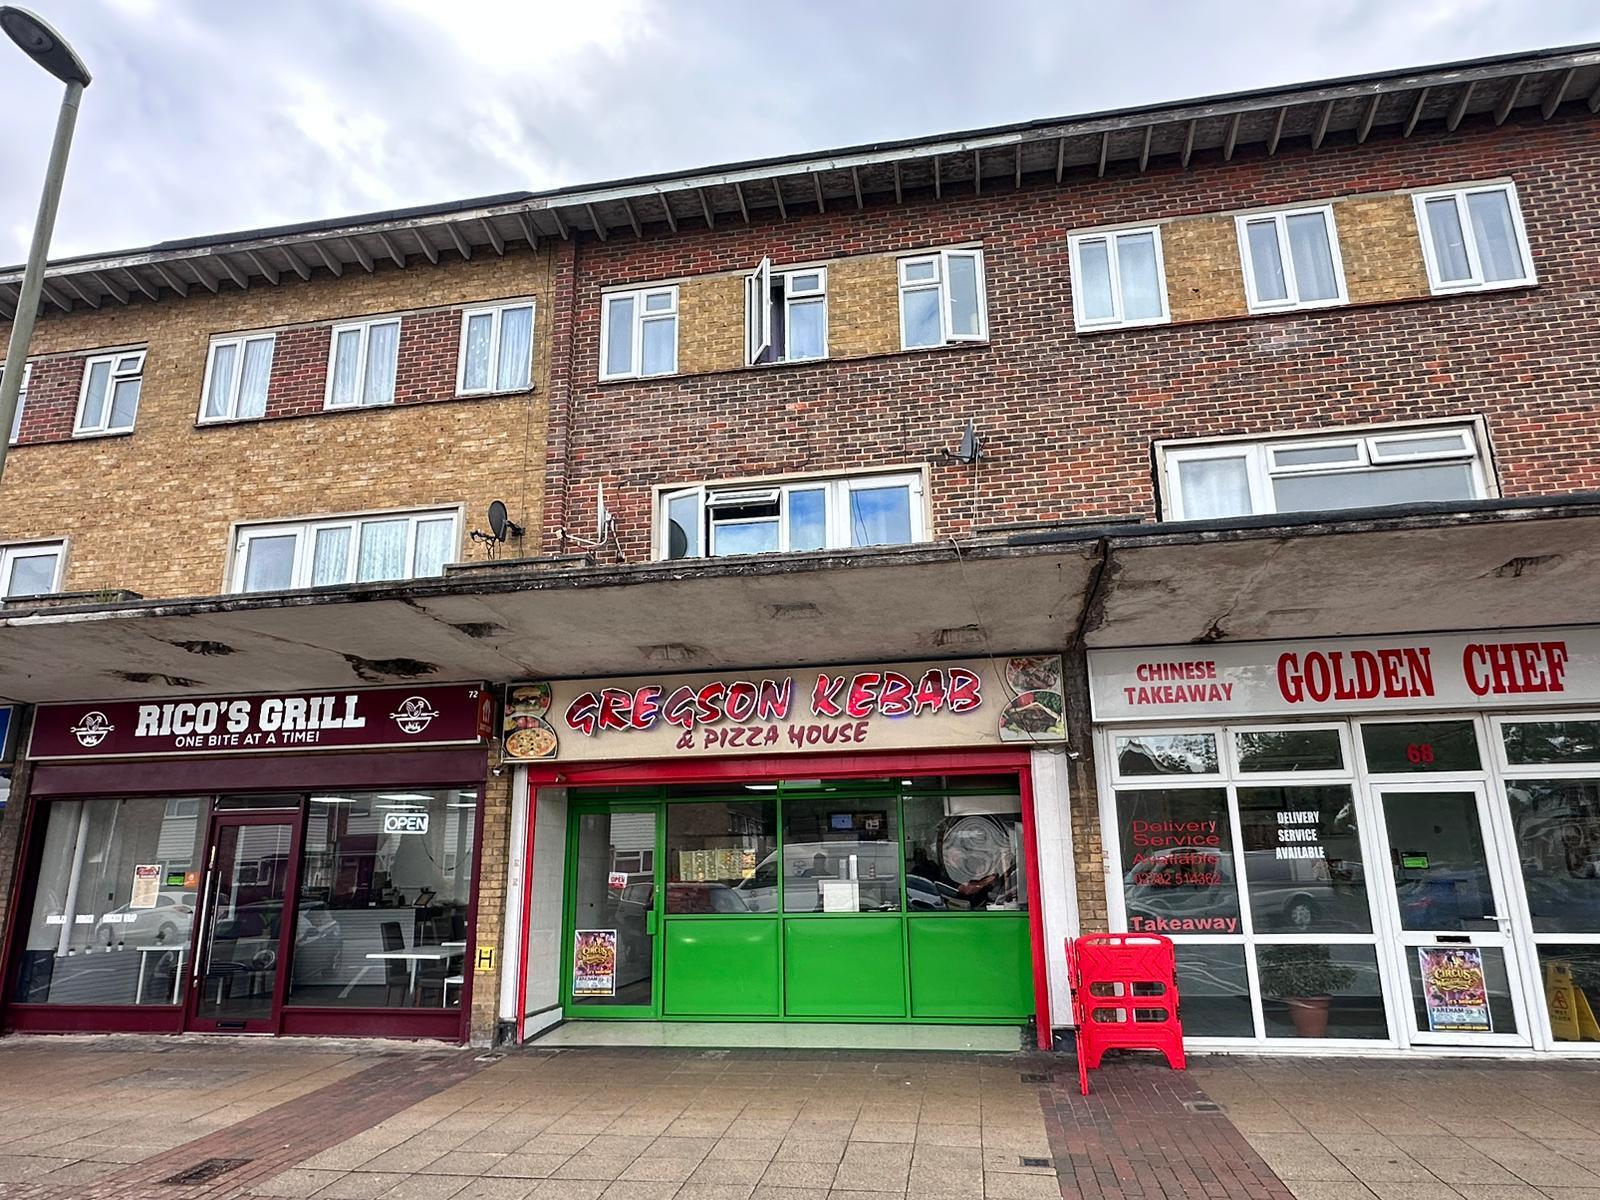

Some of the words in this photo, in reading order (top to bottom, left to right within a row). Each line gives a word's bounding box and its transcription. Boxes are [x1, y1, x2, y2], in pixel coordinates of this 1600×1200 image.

[1136, 661, 1217, 682] CHINESE
[1276, 647, 1436, 704] GOLDEN
[1463, 641, 1569, 697] CHEF
[468, 690, 479, 699] 72
[1123, 682, 1234, 705] TAKEAWAY
[564, 676, 792, 737] GREGSON
[810, 667, 983, 718] KEBAB
[134, 700, 252, 737] RICO'S
[258, 695, 366, 731] GRILL
[175, 736, 203, 748] ONE
[207, 734, 240, 746] BITE
[243, 733, 262, 745] AT
[265, 732, 276, 744] A
[281, 731, 320, 744] TIME!
[676, 729, 695, 750] &
[703, 724, 780, 749] PIZZA
[787, 721, 869, 748] HOUSE
[386, 816, 427, 831] OPEN
[1276, 810, 1320, 824] DELIVERY
[1132, 819, 1216, 833] Delivery
[1133, 833, 1220, 847] Service
[1277, 828, 1318, 842] SERVICE
[1132, 851, 1218, 865] Available
[1275, 846, 1326, 860] AVAILABLE
[1129, 915, 1237, 933] Takeaway
[478, 949, 493, 968] H
[1433, 967, 1471, 980] CIRCUS
